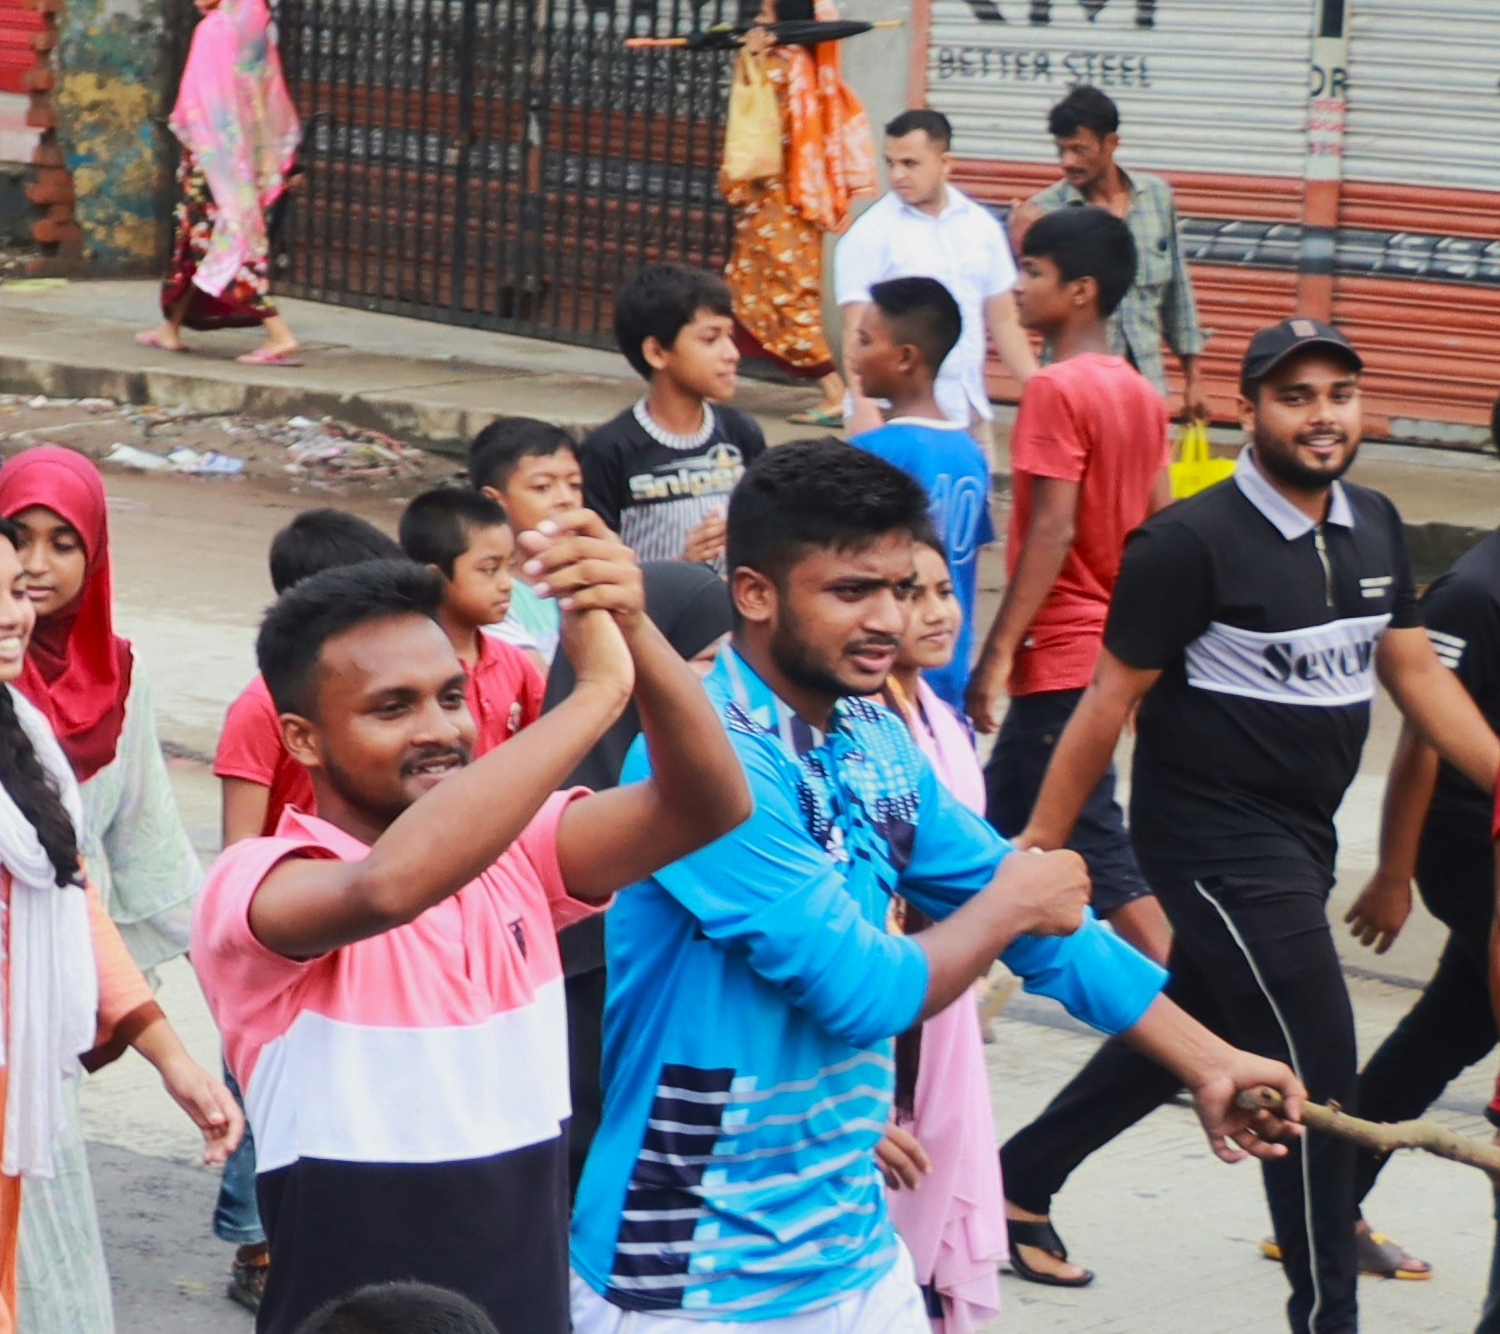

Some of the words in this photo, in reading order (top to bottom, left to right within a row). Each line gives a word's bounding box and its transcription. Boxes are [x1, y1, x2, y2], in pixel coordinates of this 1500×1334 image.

[938, 46, 1052, 83] BETTER
[1062, 52, 1154, 89] STEEL
[927, 473, 983, 565] 10
